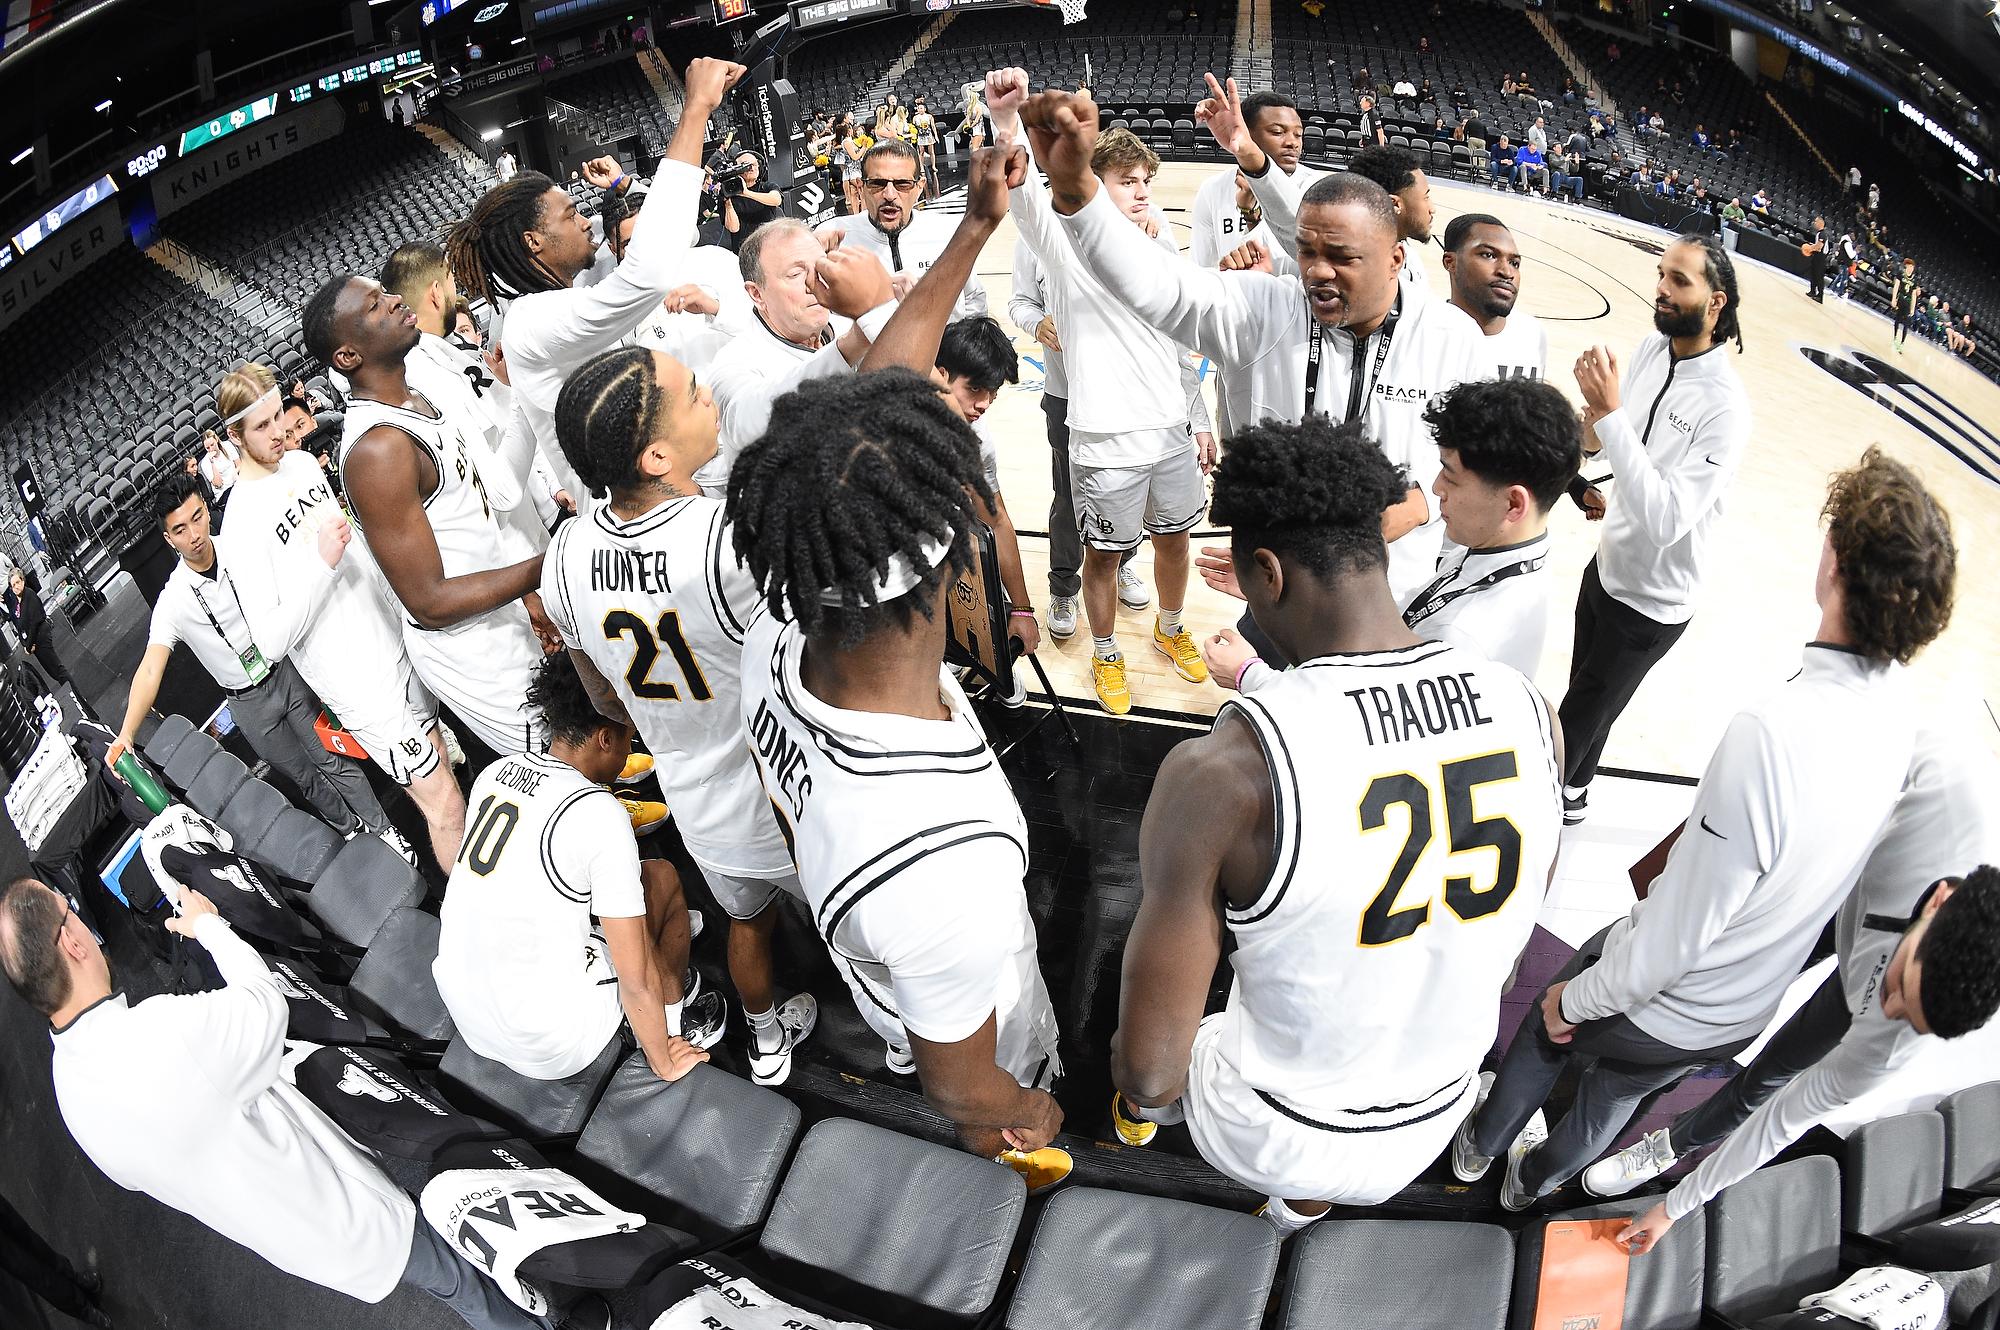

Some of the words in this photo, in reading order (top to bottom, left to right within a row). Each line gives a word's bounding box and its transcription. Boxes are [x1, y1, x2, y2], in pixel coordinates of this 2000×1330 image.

[802, 5, 826, 20] THE
[827, 1, 849, 15] BIG
[466, 79, 487, 91] THE
[488, 70, 507, 84] BIG
[507, 61, 535, 77] WEST
[757, 83, 777, 159] TicketSmarter
[127, 144, 167, 176] 20:00
[170, 125, 298, 199] KNIGHTS
[1, 225, 105, 314] SILVER
[1309, 339, 1320, 365] WEST
[1377, 334, 1391, 359] WEST
[1376, 383, 1427, 400] BEACH
[21, 479, 36, 502] C
[275, 483, 330, 546] BEACH
[591, 548, 672, 595] HUNTER
[601, 608, 715, 703] 21
[1344, 672, 1493, 746] TRAORE
[495, 761, 549, 797] GEORGE
[747, 696, 813, 824] JONES
[457, 793, 520, 878] 10
[1356, 748, 1523, 949] 25
[299, 981, 349, 1021] HERCULES
[337, 1046, 377, 1073] TIRES
[373, 1070, 449, 1116] HERCULES
[449, 1186, 503, 1226] SPORTS
